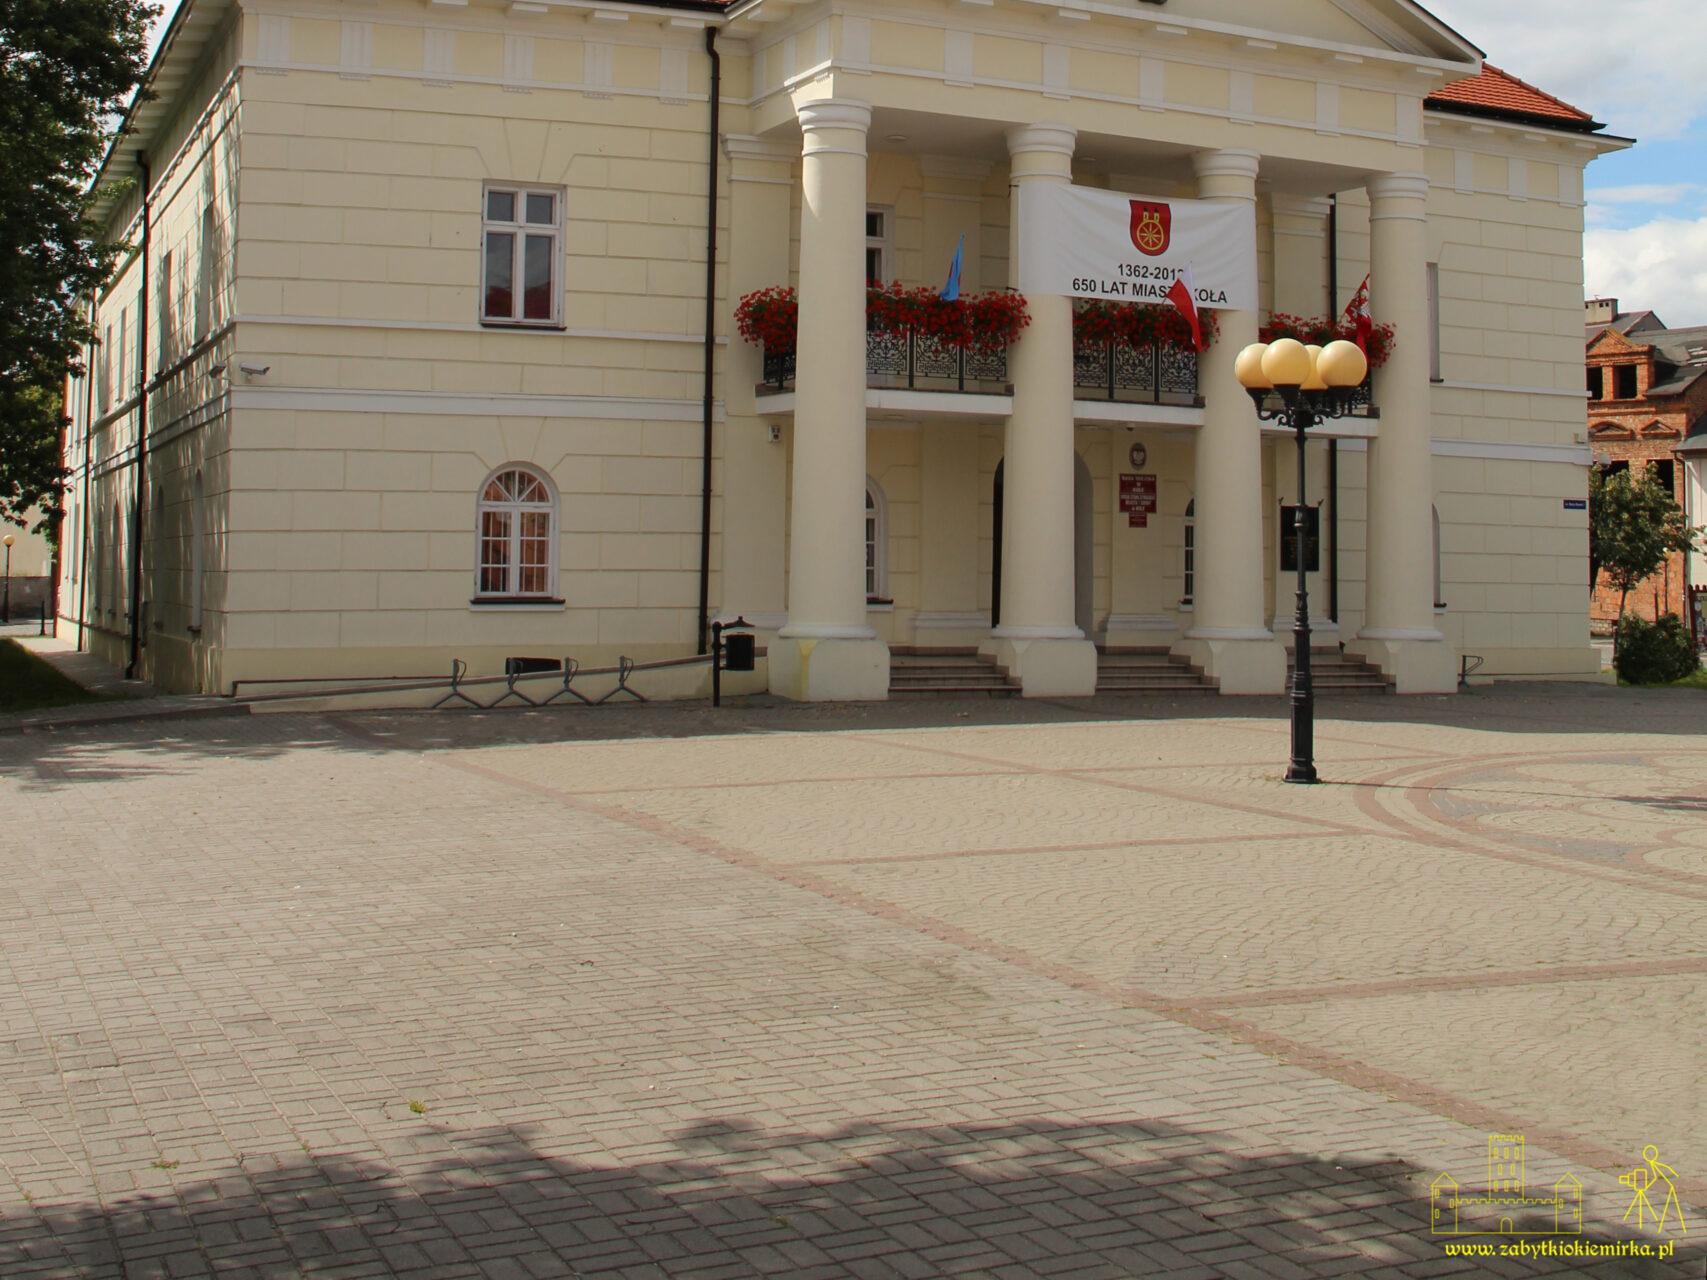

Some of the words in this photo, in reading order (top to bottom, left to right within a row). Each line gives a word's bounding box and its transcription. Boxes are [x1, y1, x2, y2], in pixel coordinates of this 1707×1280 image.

[1118, 263, 1184, 281] 1362-201
[1072, 278, 1097, 292] 650
[1101, 280, 1128, 295] LAT
[1132, 283, 1172, 299] MIAS
